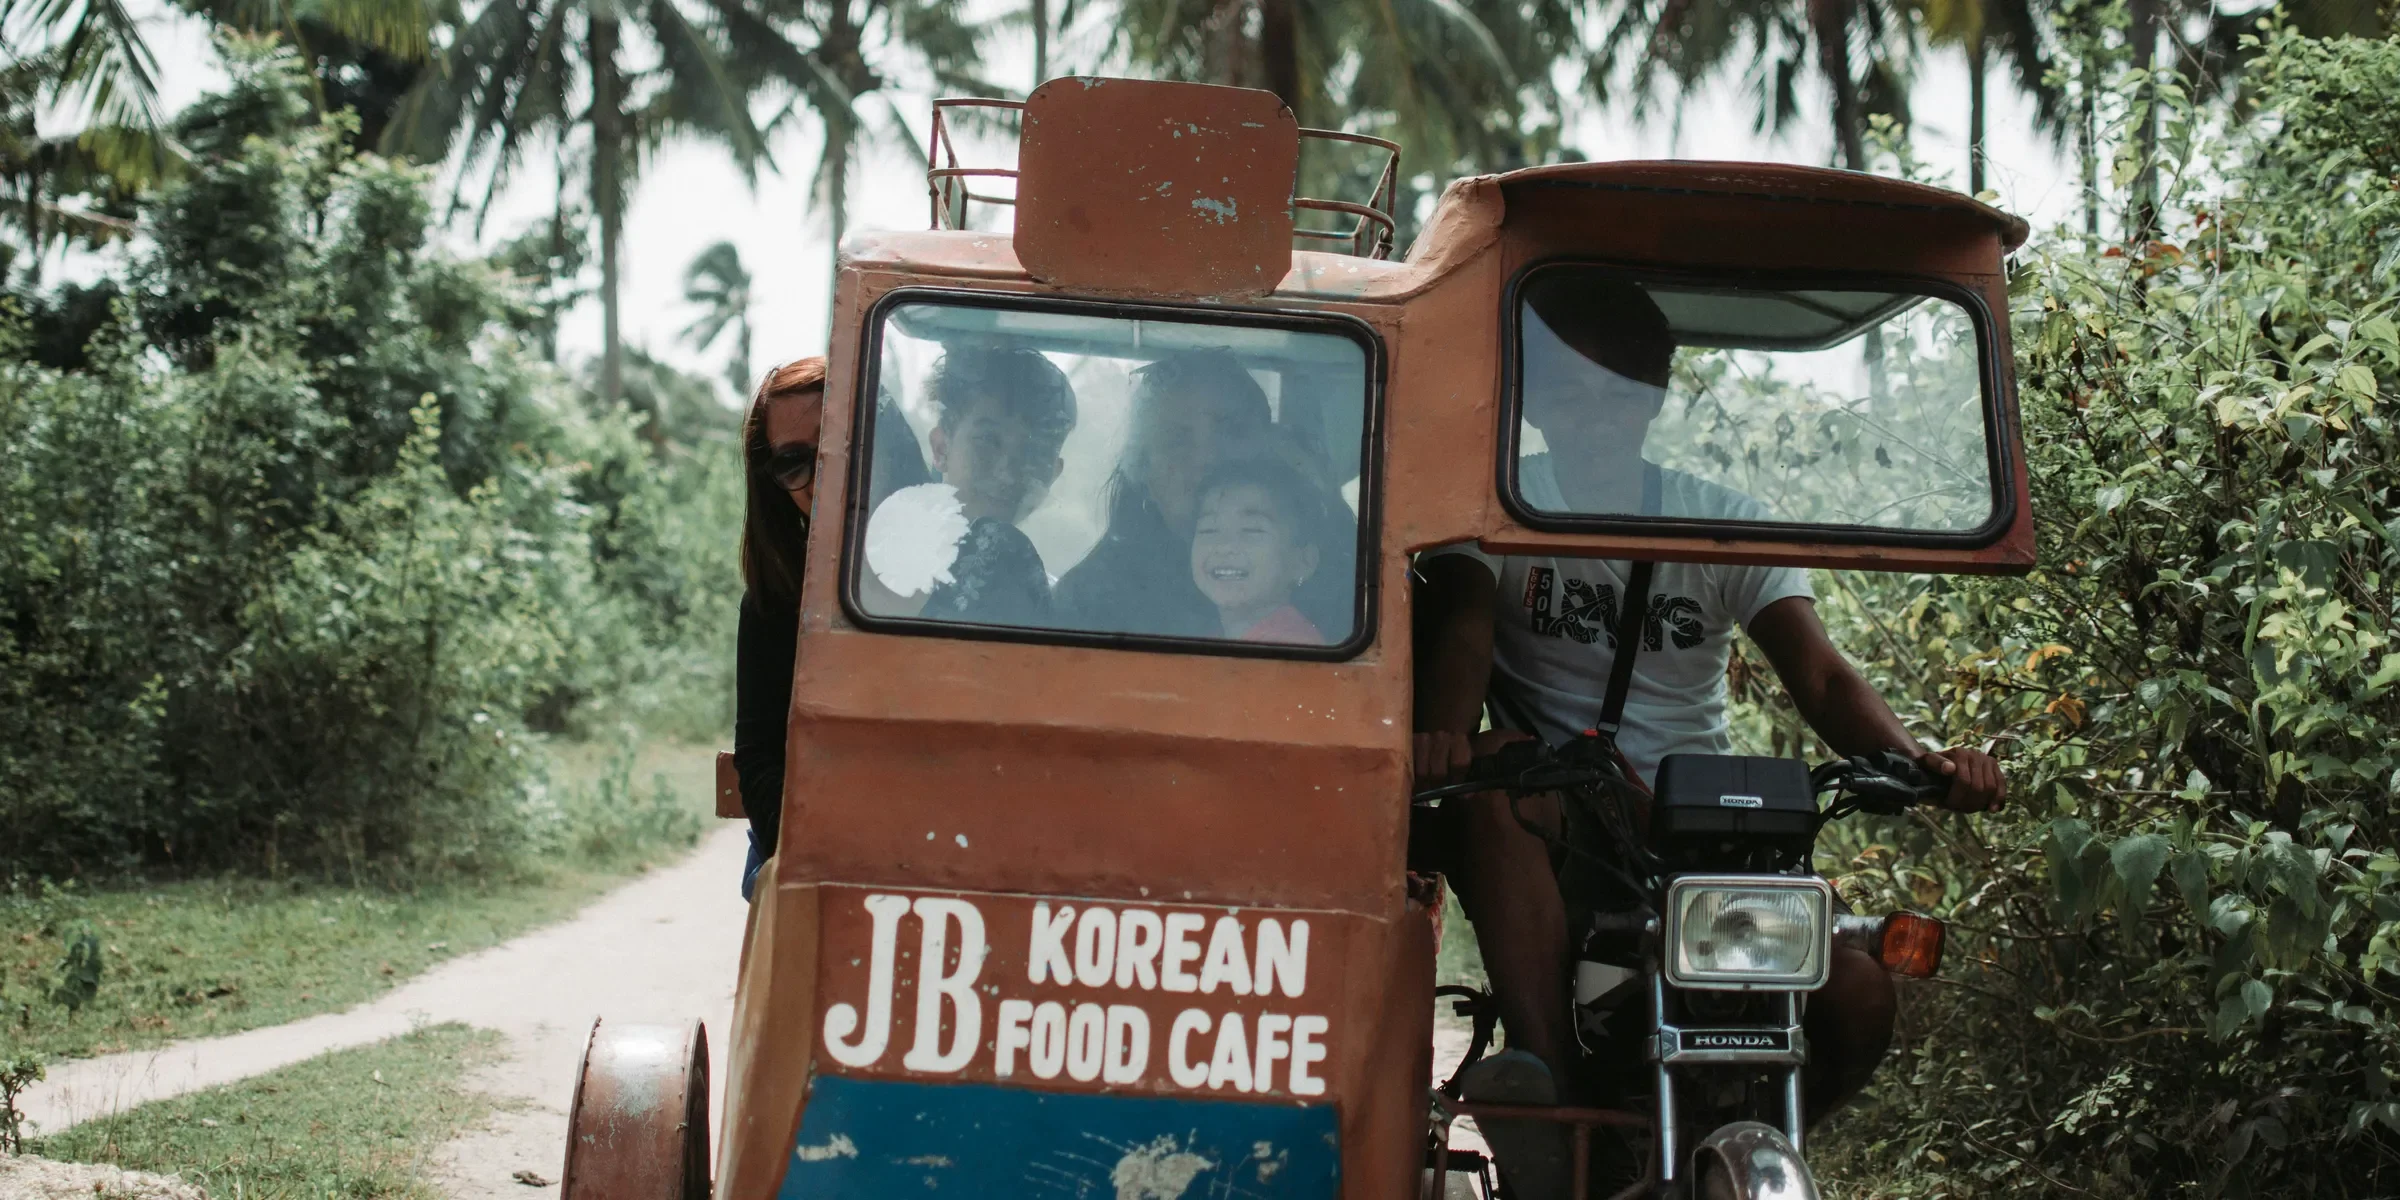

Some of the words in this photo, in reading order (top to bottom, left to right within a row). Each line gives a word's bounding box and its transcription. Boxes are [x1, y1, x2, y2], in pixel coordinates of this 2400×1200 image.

[1536, 573, 1551, 633] 501
[824, 894, 987, 1072] JB
[1028, 901, 1309, 998] KOREAN
[995, 1000, 1150, 1084] FOOD
[1168, 1009, 1329, 1096] CAFE
[1694, 1035, 1775, 1046] HONDA
